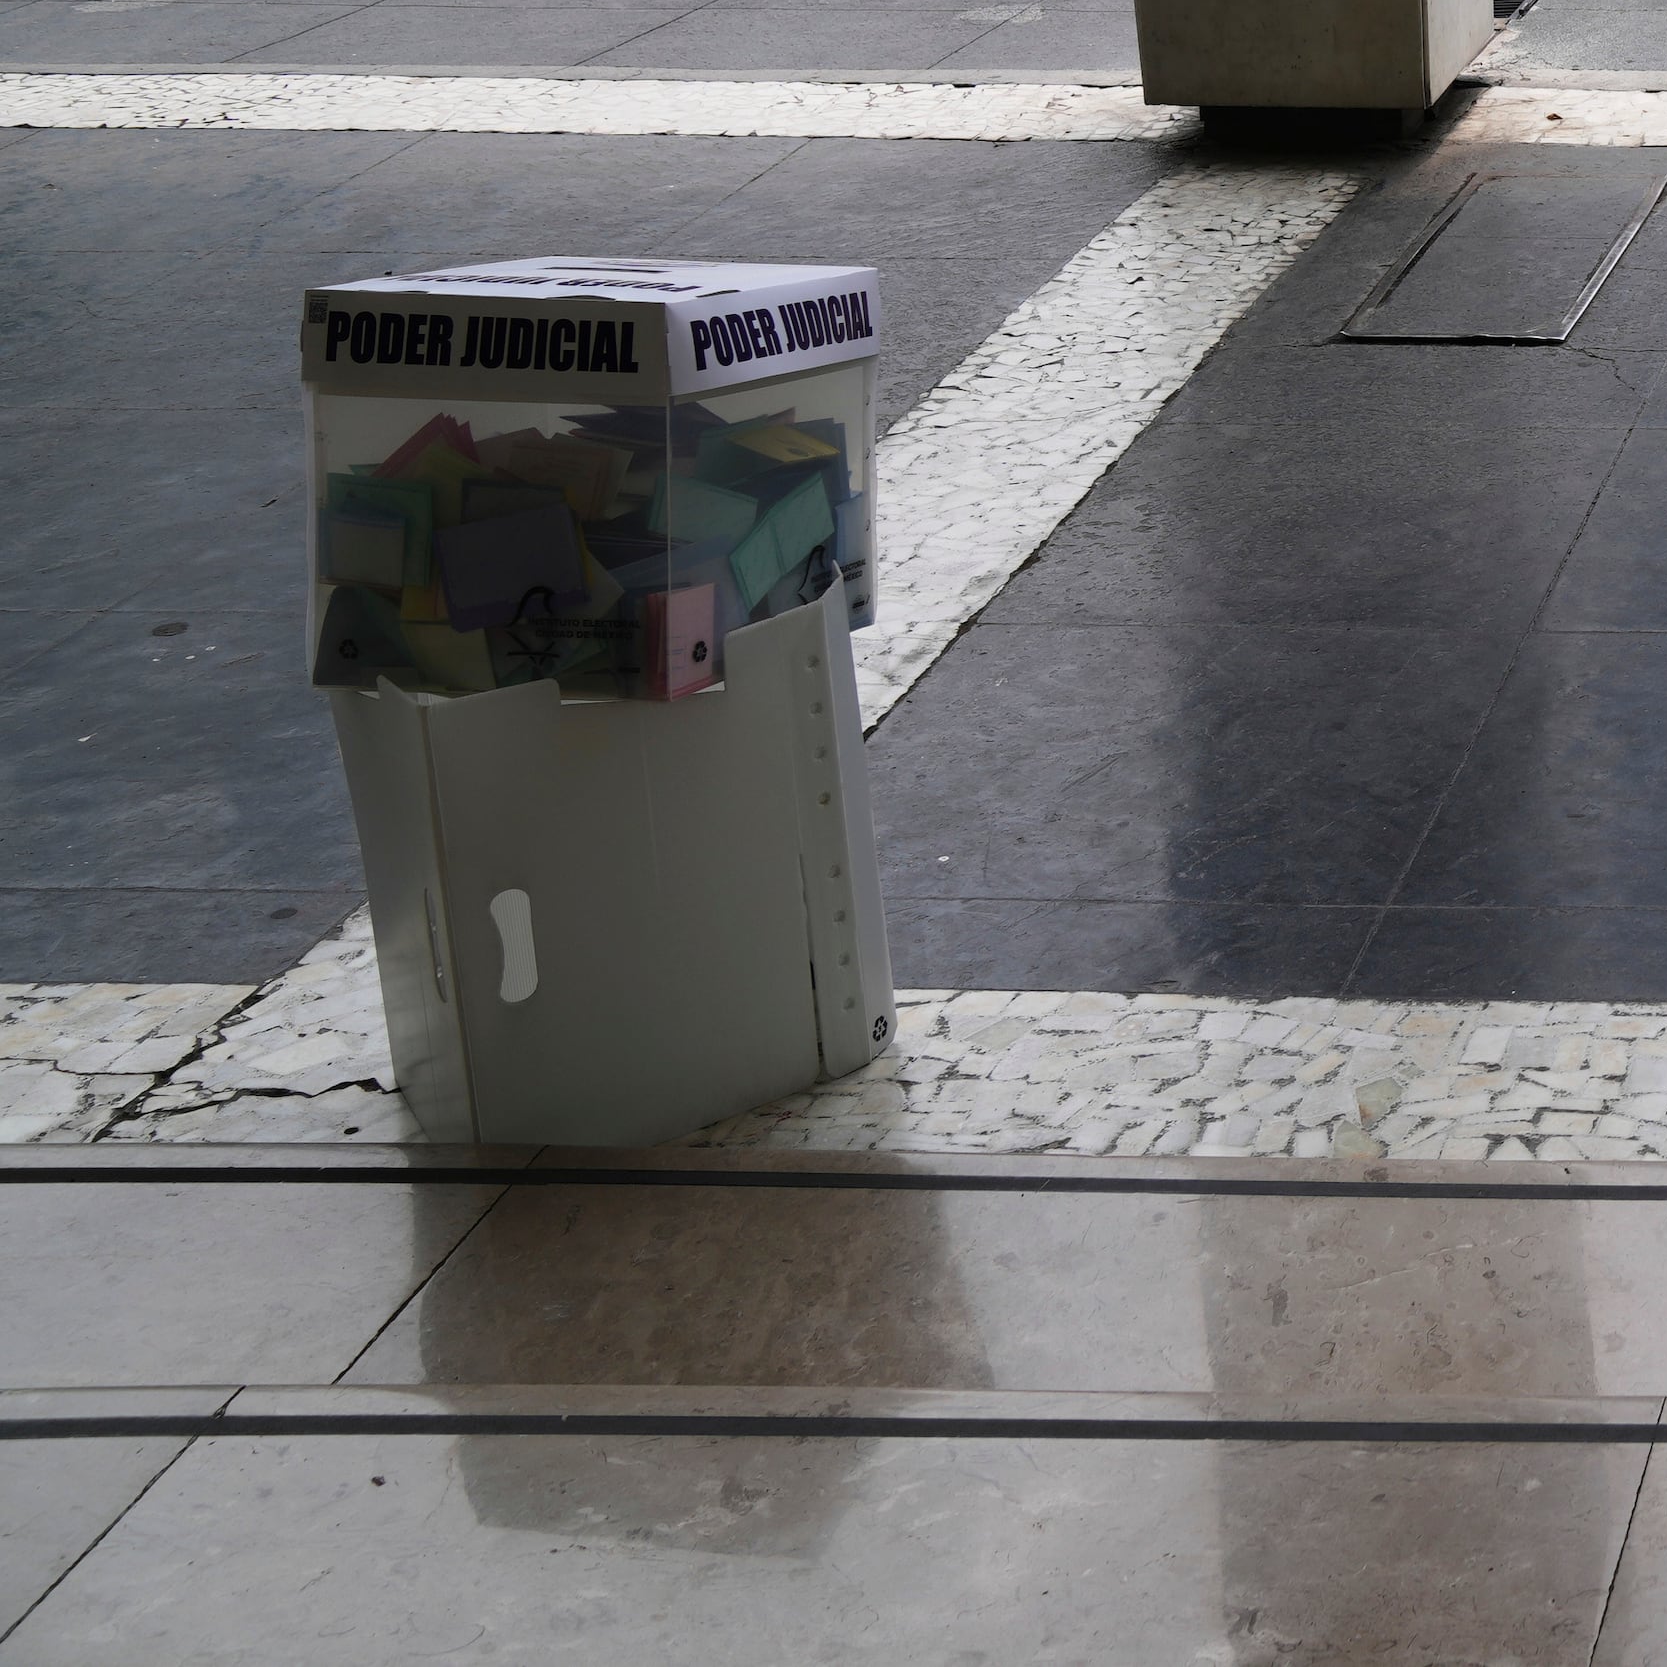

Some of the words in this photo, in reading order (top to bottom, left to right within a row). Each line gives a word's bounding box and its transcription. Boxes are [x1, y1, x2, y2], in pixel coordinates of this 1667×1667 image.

[324, 310, 455, 367] PODER
[460, 315, 640, 374] JUDICIAL
[690, 305, 783, 371] PODER
[779, 290, 874, 356] JUDICIAL
